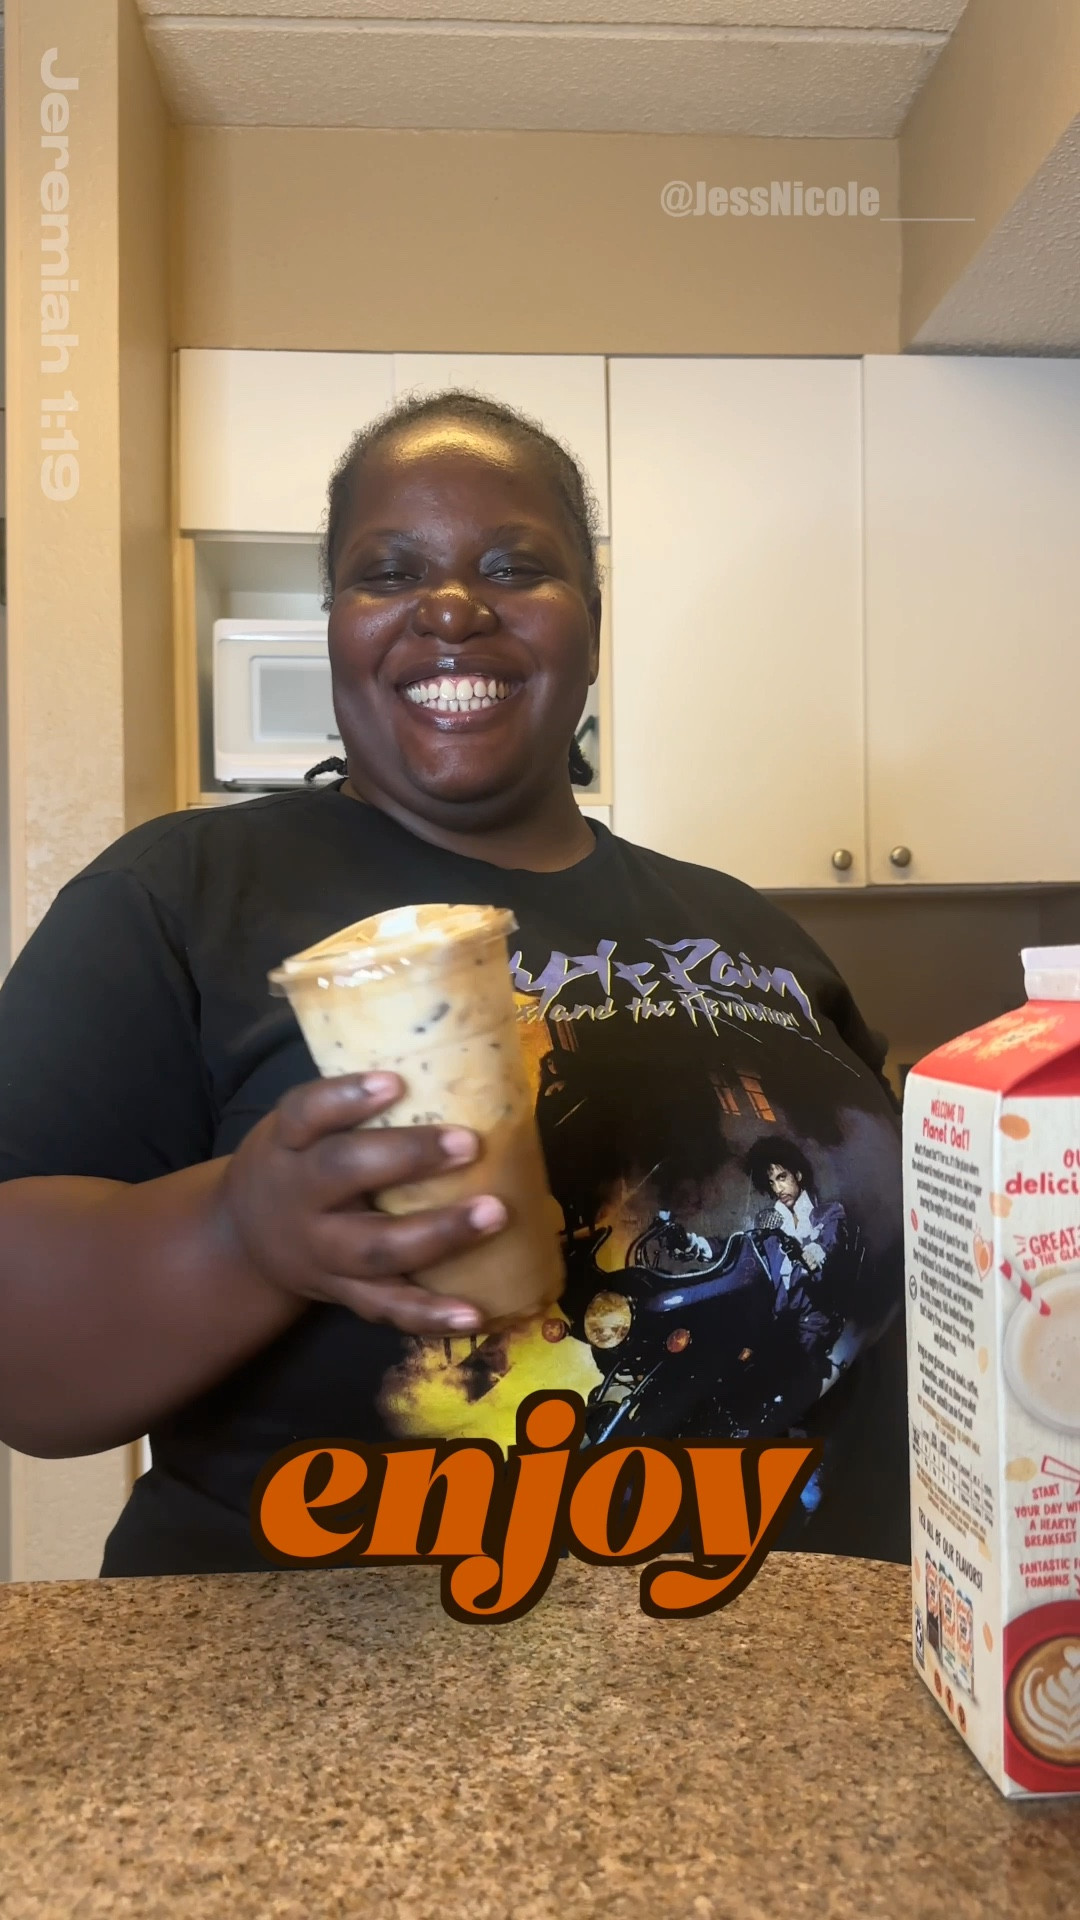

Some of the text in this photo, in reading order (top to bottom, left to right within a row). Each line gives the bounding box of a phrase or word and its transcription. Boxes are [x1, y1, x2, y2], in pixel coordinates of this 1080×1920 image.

[645, 938, 822, 1036] Rain
[549, 997, 618, 1022] and
[625, 997, 676, 1024] the
[930, 1099, 956, 1122] WELCOME
[922, 1117, 947, 1145] Planet
[1031, 1483, 1060, 1499] START
[1015, 1504, 1041, 1518] YOUR
[1044, 1502, 1062, 1515] DAY
[1030, 1517, 1077, 1531] A HEARTY
[1024, 1531, 1077, 1548] BREAKFAST
[1019, 1557, 1070, 1575] FANTASTIC
[1025, 1574, 1069, 1588] FOAMING
